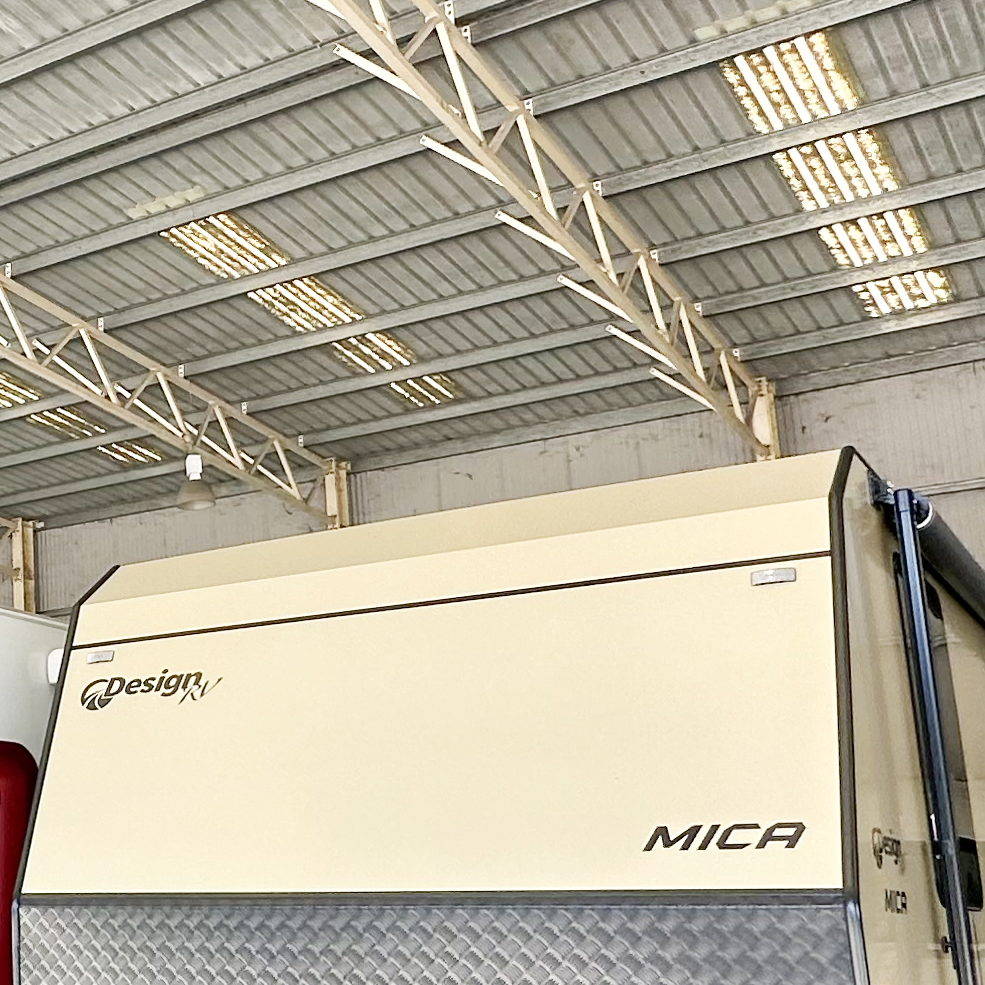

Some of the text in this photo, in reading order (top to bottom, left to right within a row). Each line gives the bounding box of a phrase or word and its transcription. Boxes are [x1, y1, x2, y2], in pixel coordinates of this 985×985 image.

[104, 669, 223, 705] Design RV
[642, 822, 806, 852] MICA
